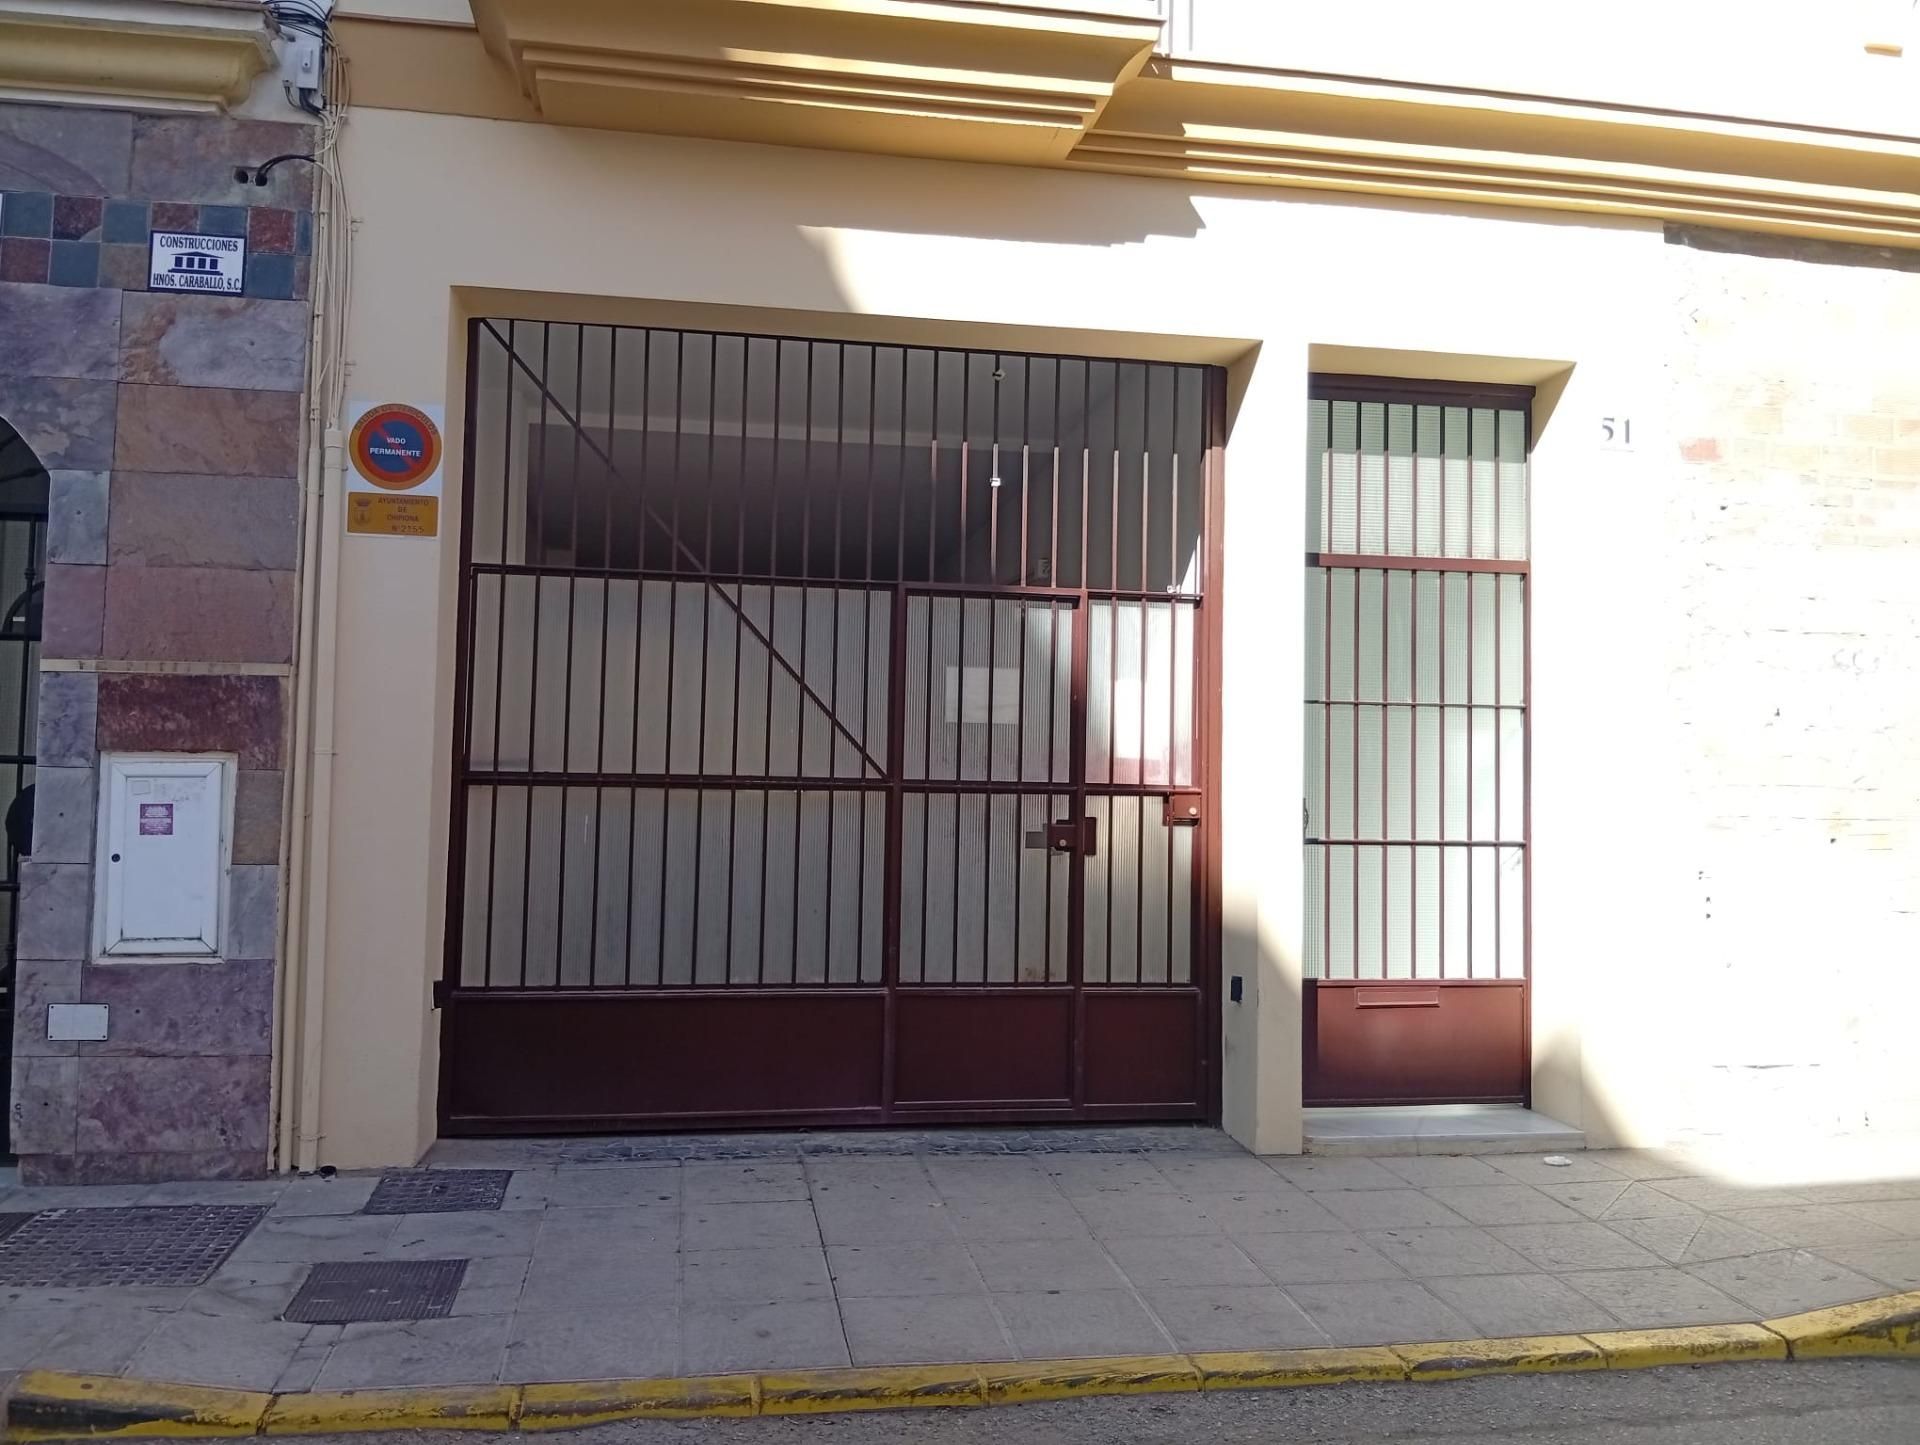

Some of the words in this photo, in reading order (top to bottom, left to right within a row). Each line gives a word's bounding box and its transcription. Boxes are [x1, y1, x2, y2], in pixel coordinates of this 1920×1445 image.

[160, 236, 238, 252] CONSTRUCCIONES
[153, 273, 177, 287] HNOS.
[178, 275, 225, 291] CARABALLO,
[1602, 417, 1630, 444] 51
[386, 437, 406, 445] VADO
[369, 447, 422, 457] PERMANENTE
